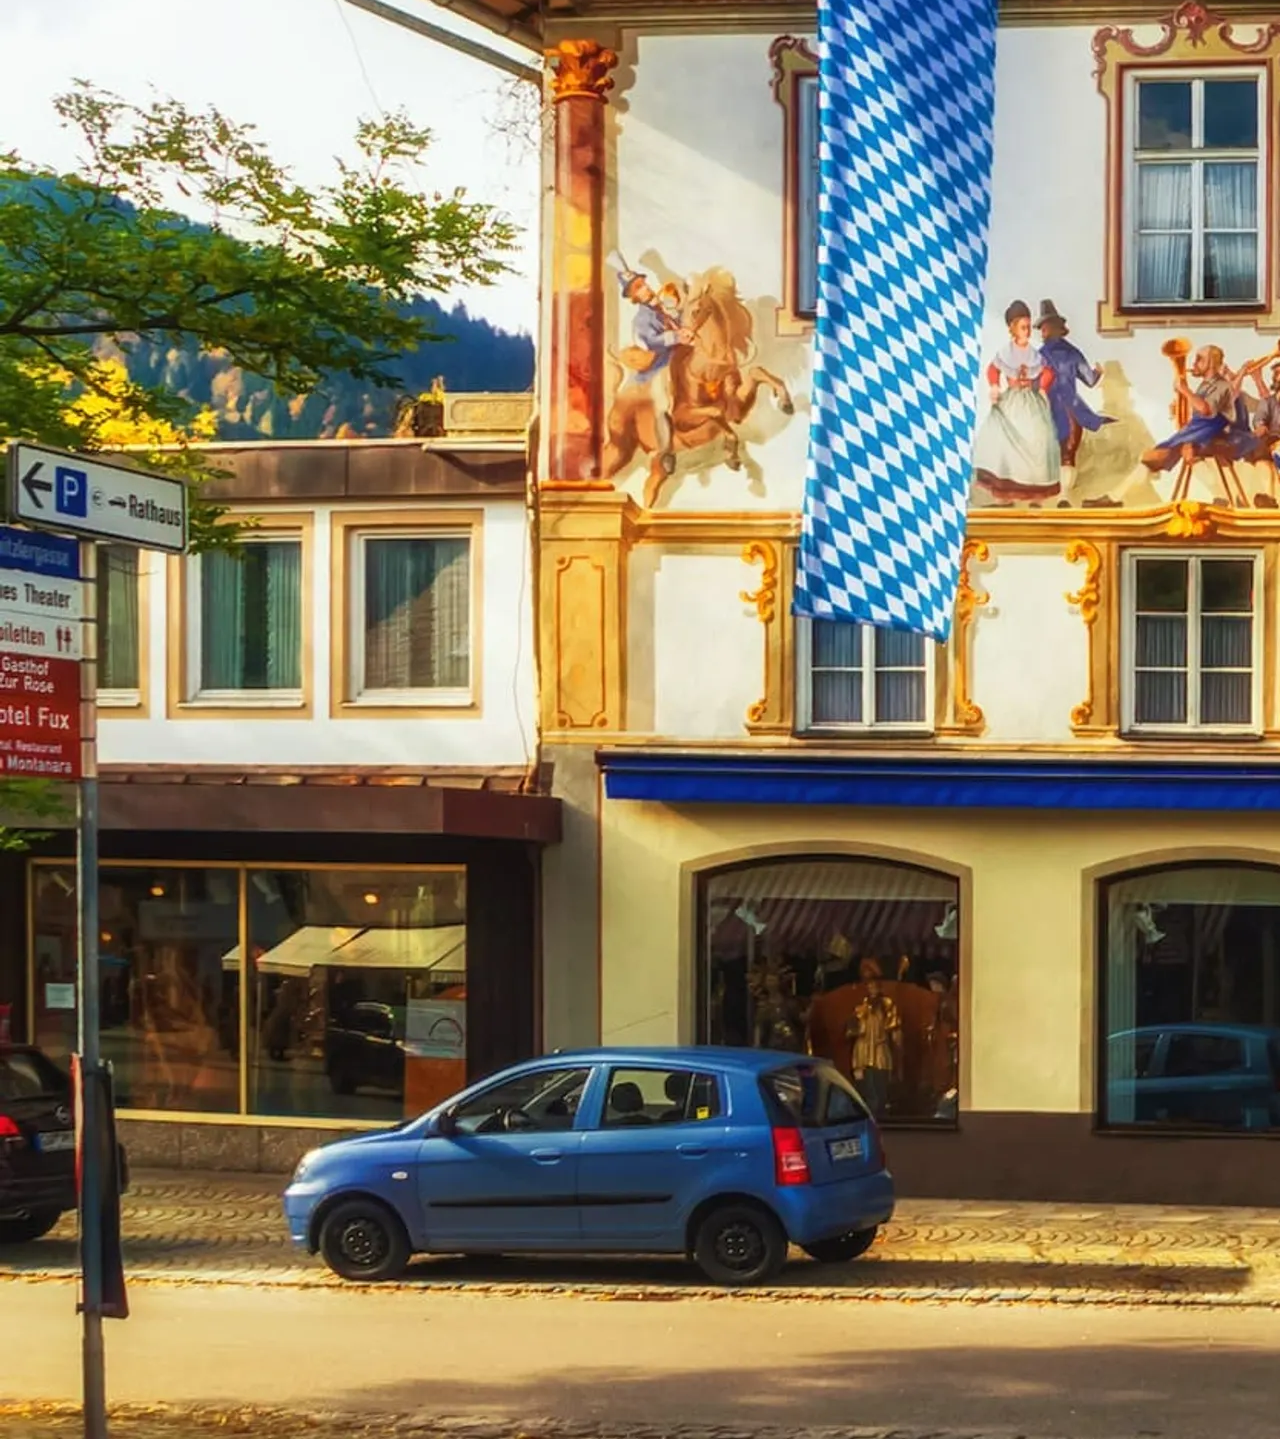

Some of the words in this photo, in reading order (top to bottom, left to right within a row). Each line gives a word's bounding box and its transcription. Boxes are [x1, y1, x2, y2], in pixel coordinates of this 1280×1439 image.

[63, 475, 79, 507] P
[128, 493, 182, 527] Rathaus
[24, 582, 72, 609] Theater
[2, 656, 49, 676] Gasthof
[24, 675, 55, 693] Rose
[37, 706, 70, 730] Fux
[7, 754, 72, 774] Montanara
